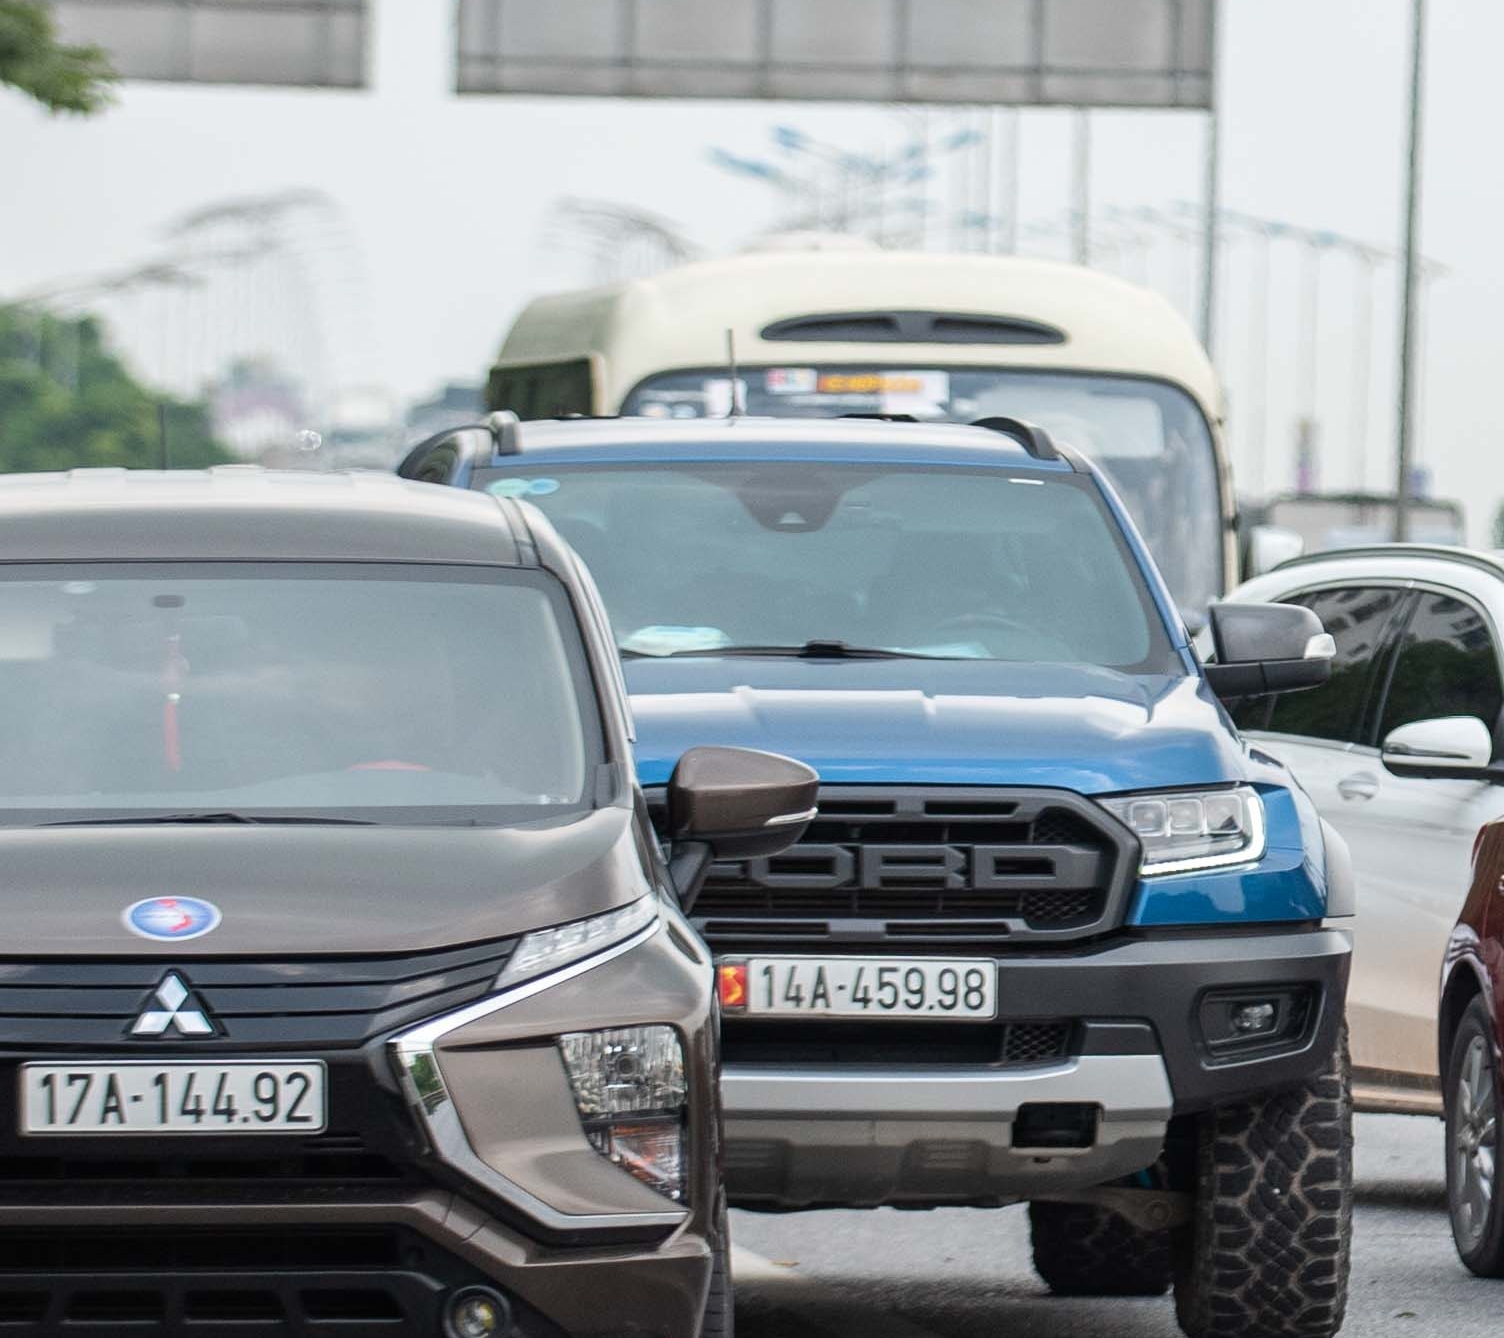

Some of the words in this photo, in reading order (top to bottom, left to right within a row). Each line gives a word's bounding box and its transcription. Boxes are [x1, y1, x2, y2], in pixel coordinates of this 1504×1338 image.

[708, 844, 1098, 889] ORD
[762, 968, 987, 1013] 14A-459.98
[40, 1071, 314, 1125] 17A-144.92
